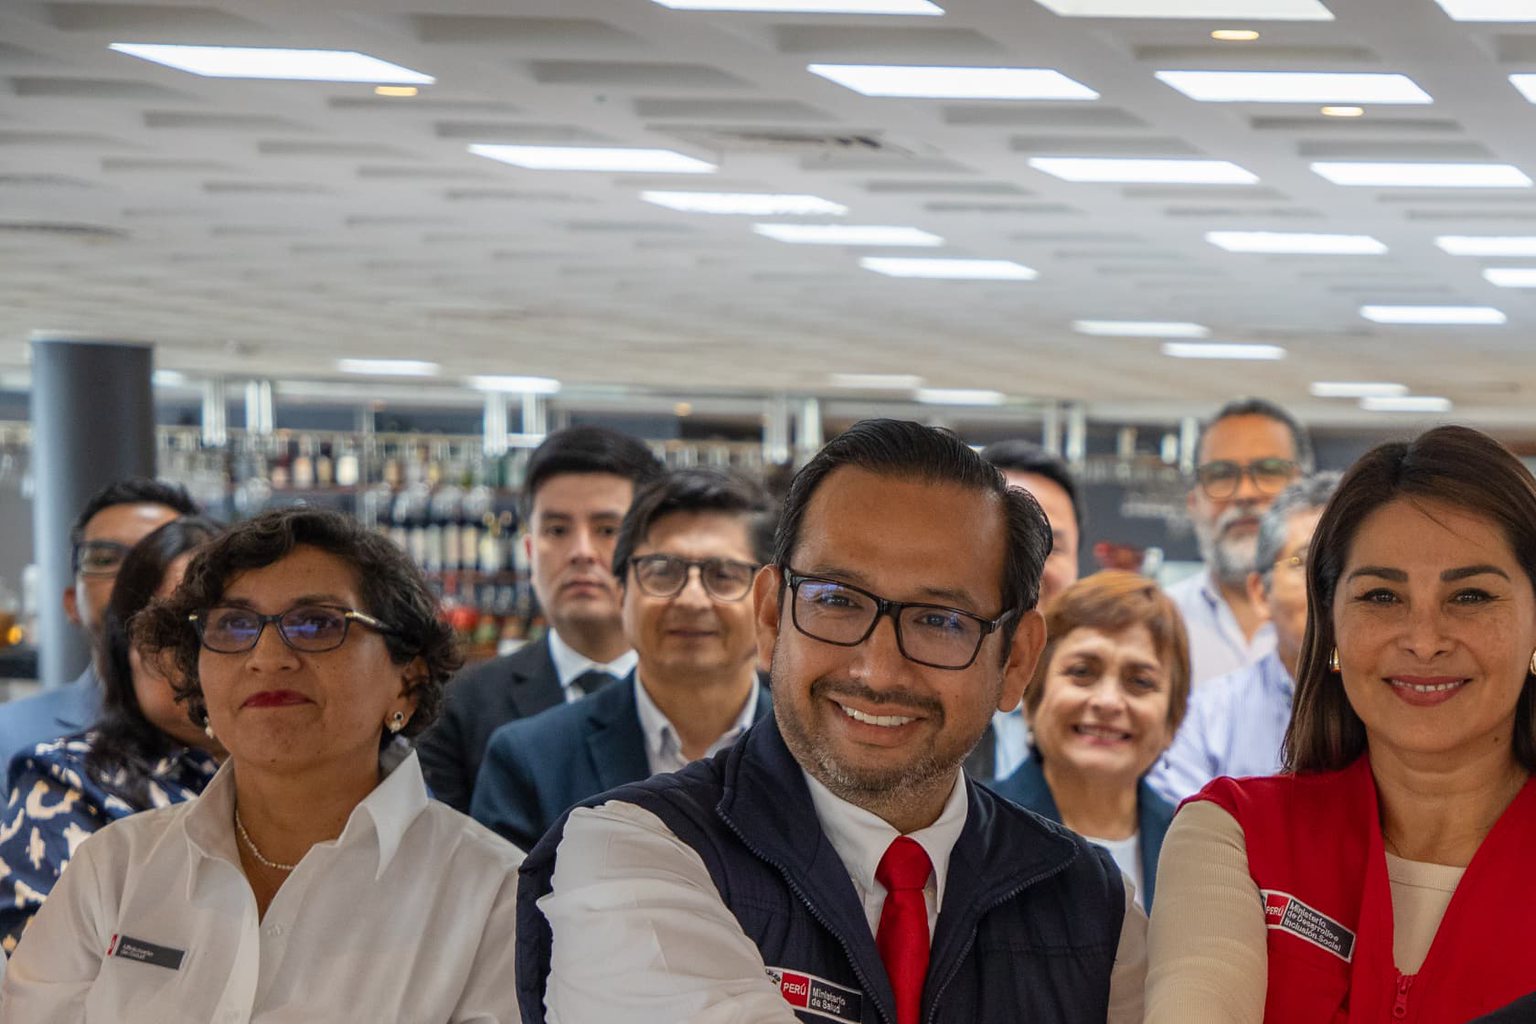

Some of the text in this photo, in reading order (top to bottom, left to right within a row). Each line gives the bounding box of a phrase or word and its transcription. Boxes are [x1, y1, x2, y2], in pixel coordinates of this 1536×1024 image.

[1266, 905, 1285, 917] PERÚ
[1289, 901, 1327, 928] Ministerio
[1287, 910, 1297, 919] de
[1297, 915, 1335, 939] Desarrollo
[1284, 917, 1342, 952] Inclusión Social
[782, 982, 807, 996] PERÚ
[812, 987, 846, 1006] Ministerio
[811, 998, 841, 1014] de Salud
